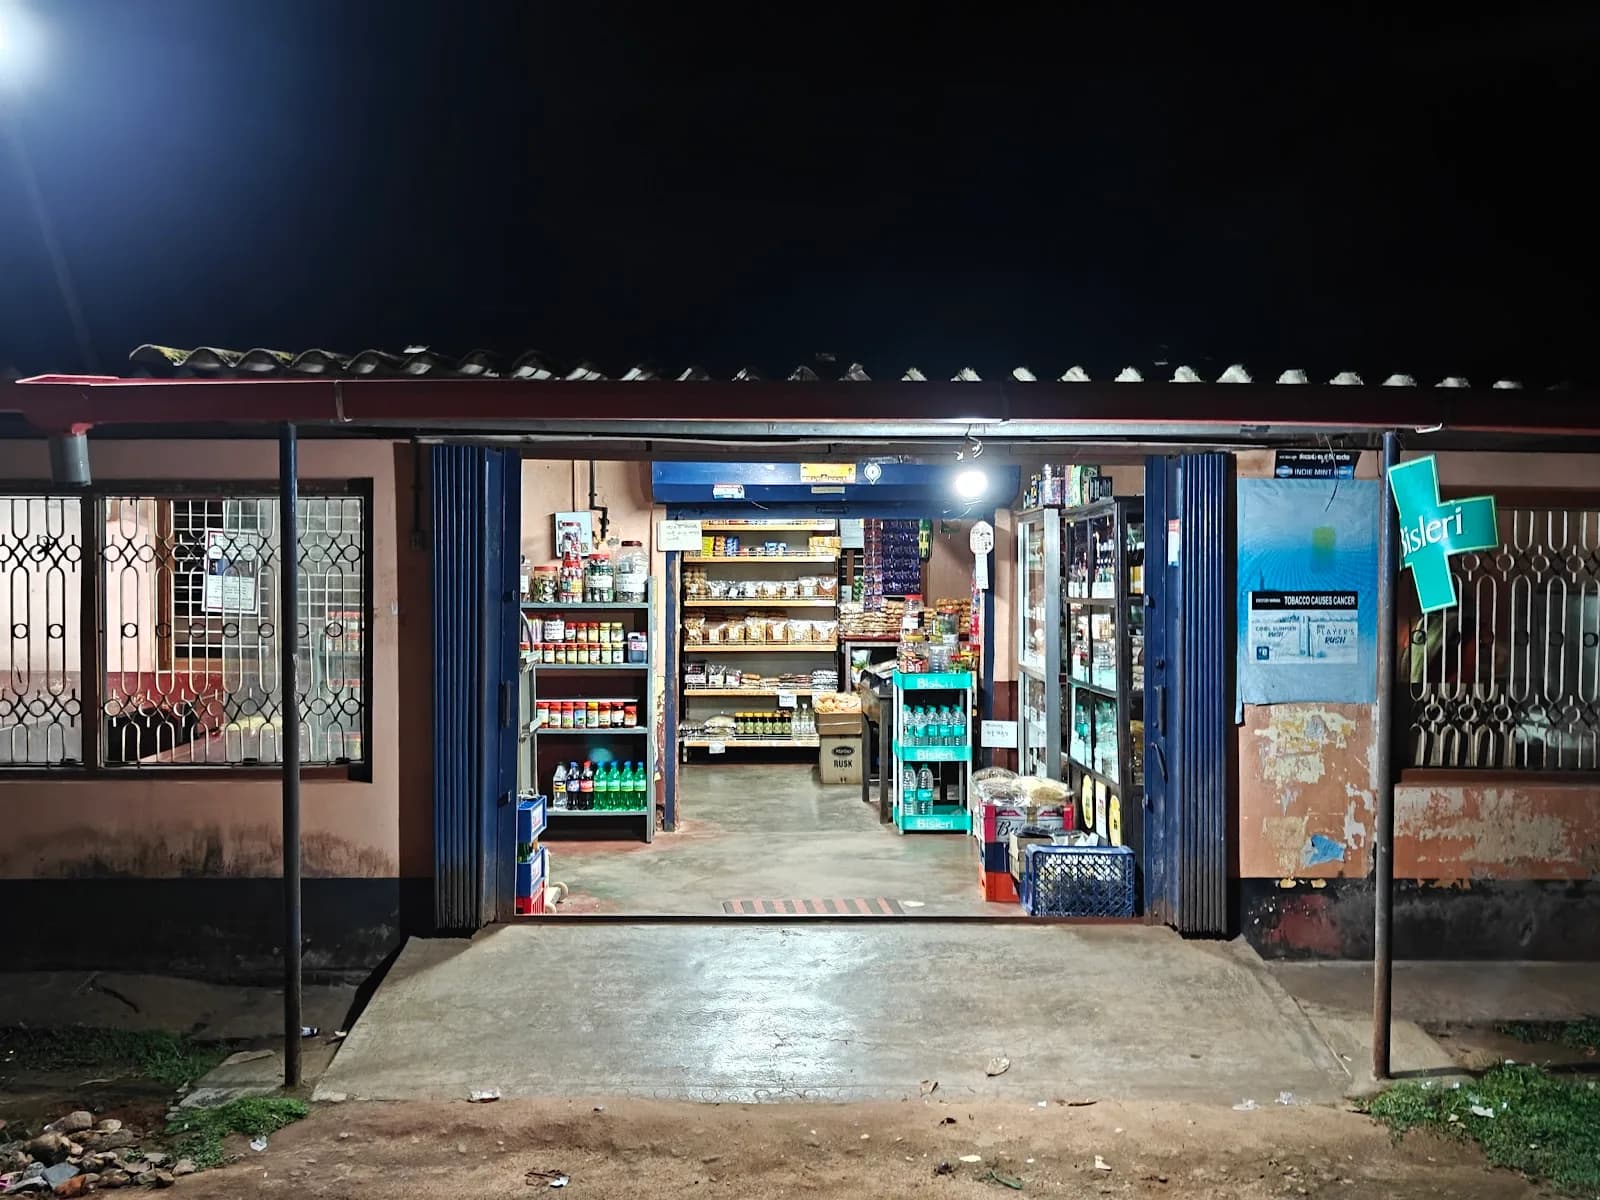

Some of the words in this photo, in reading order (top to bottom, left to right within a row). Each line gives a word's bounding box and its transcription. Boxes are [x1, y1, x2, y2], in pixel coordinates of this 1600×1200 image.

[1294, 468, 1313, 476] INDIE
[1314, 468, 1332, 476] MINT
[1284, 595, 1311, 605] TOBACCO
[1311, 595, 1333, 605] CAUSES
[1333, 595, 1356, 605] CANCER
[833, 759, 853, 769] RUSK
